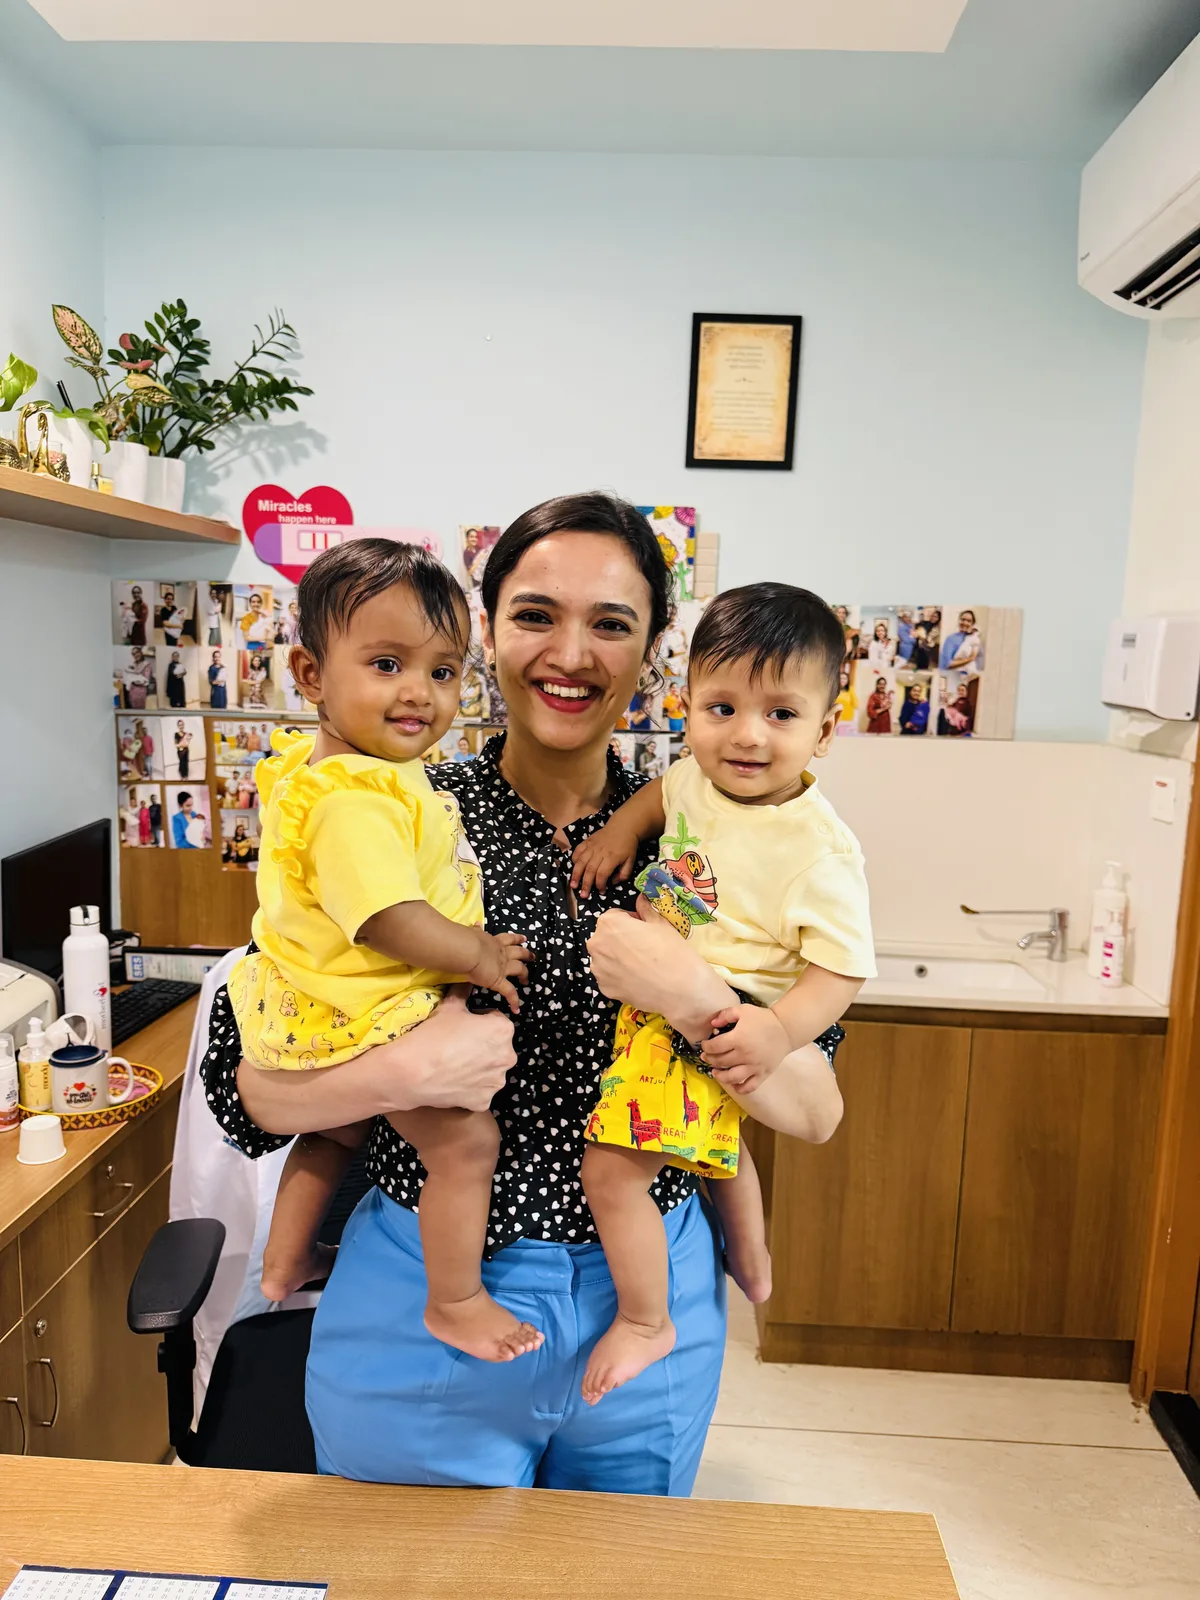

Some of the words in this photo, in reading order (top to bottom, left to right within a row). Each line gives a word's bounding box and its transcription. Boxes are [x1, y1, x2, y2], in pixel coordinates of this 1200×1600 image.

[258, 500, 312, 513] Miracles
[278, 514, 313, 524] happen
[316, 515, 337, 524] here
[132, 957, 144, 977] SRS
[640, 1074, 654, 1084] ART
[663, 1127, 686, 1140] REATE
[712, 1133, 738, 1145] CREAT
